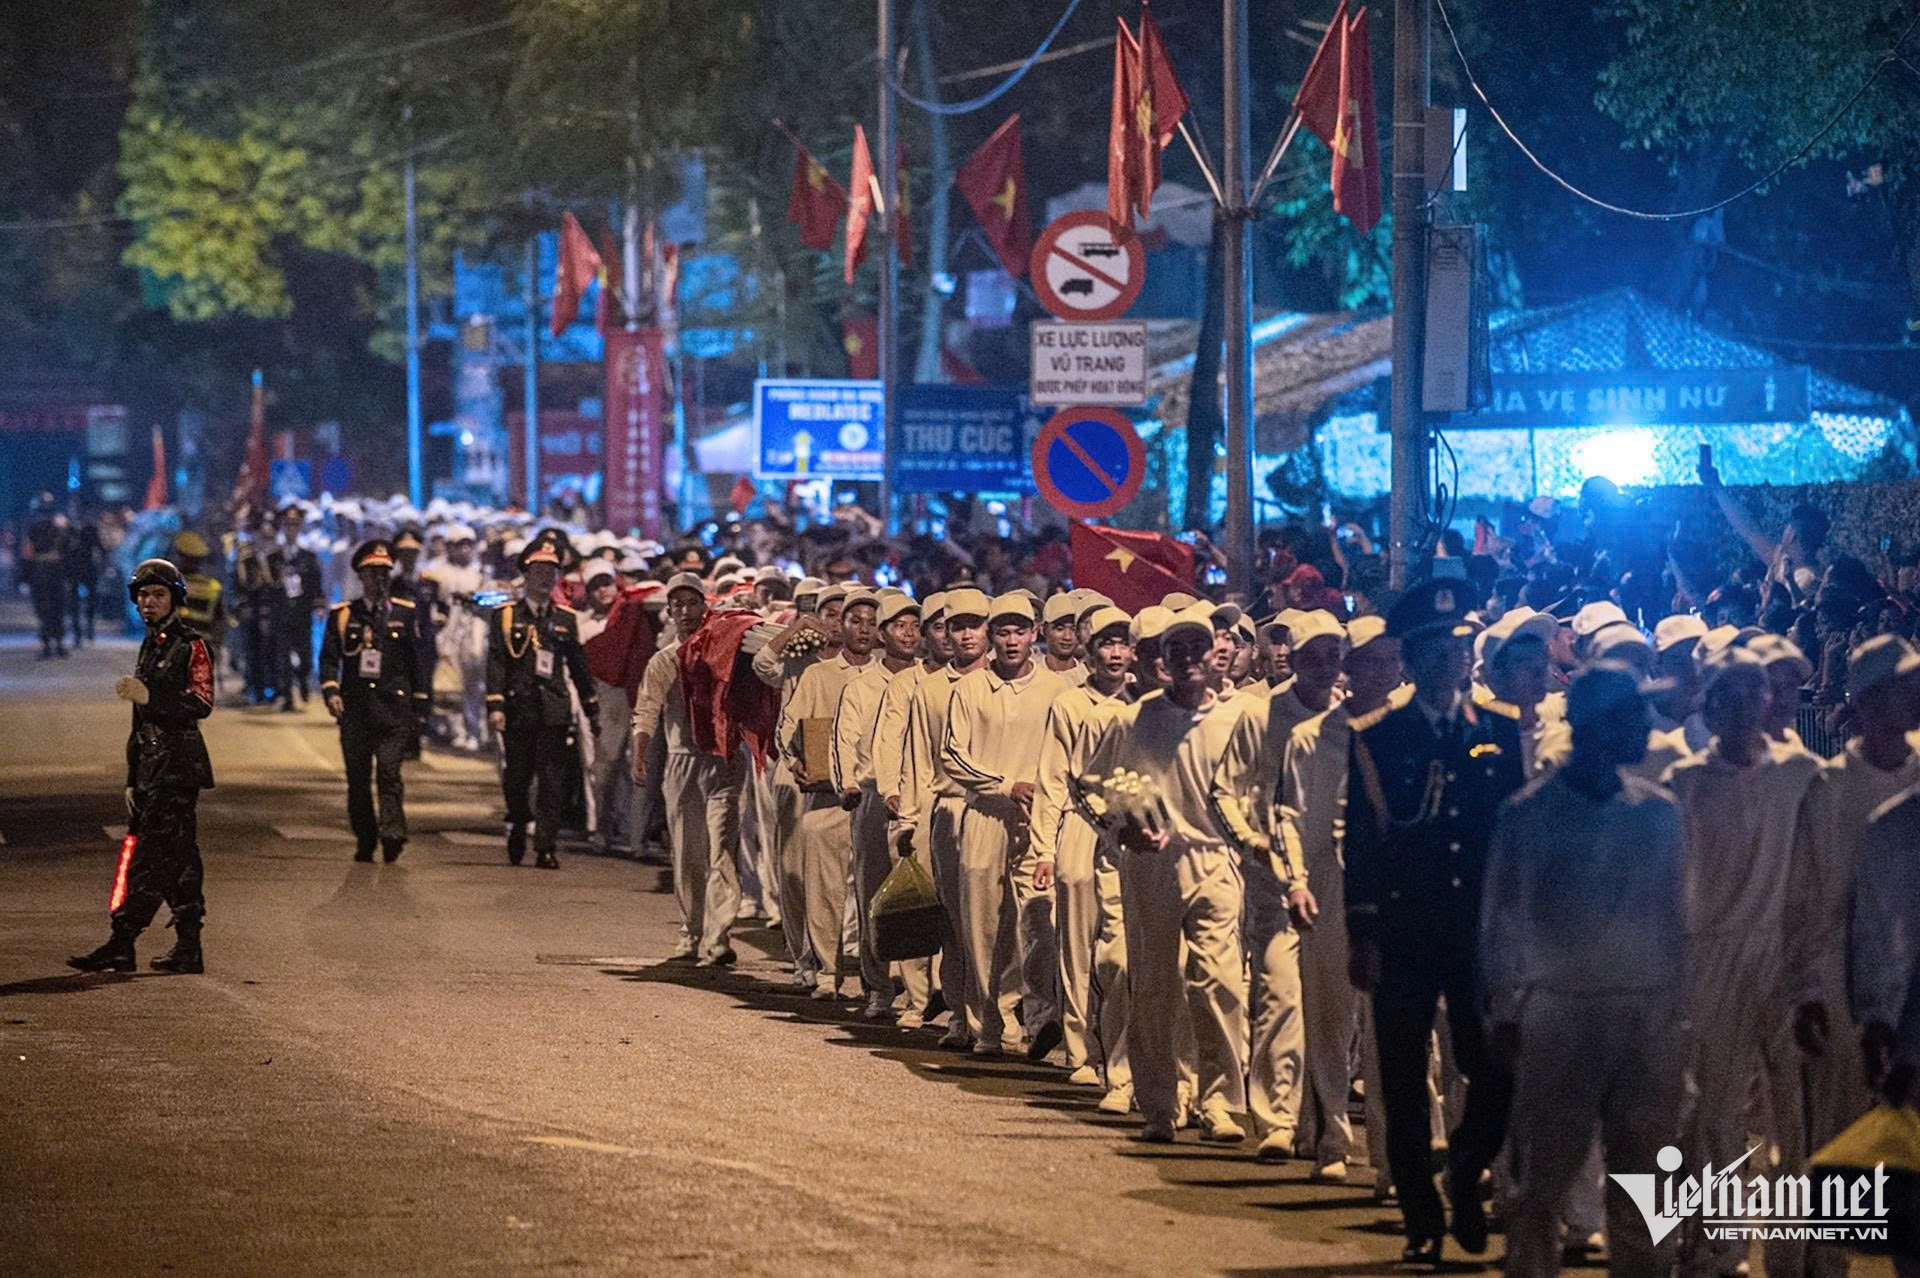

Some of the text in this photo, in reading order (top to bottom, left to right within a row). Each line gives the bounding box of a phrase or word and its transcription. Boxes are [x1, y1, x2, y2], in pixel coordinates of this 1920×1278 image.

[1038, 331, 1056, 347] XE
[1075, 356, 1126, 373] TRANG
[1586, 387, 1667, 412] SINH
[903, 424, 954, 453] THU
